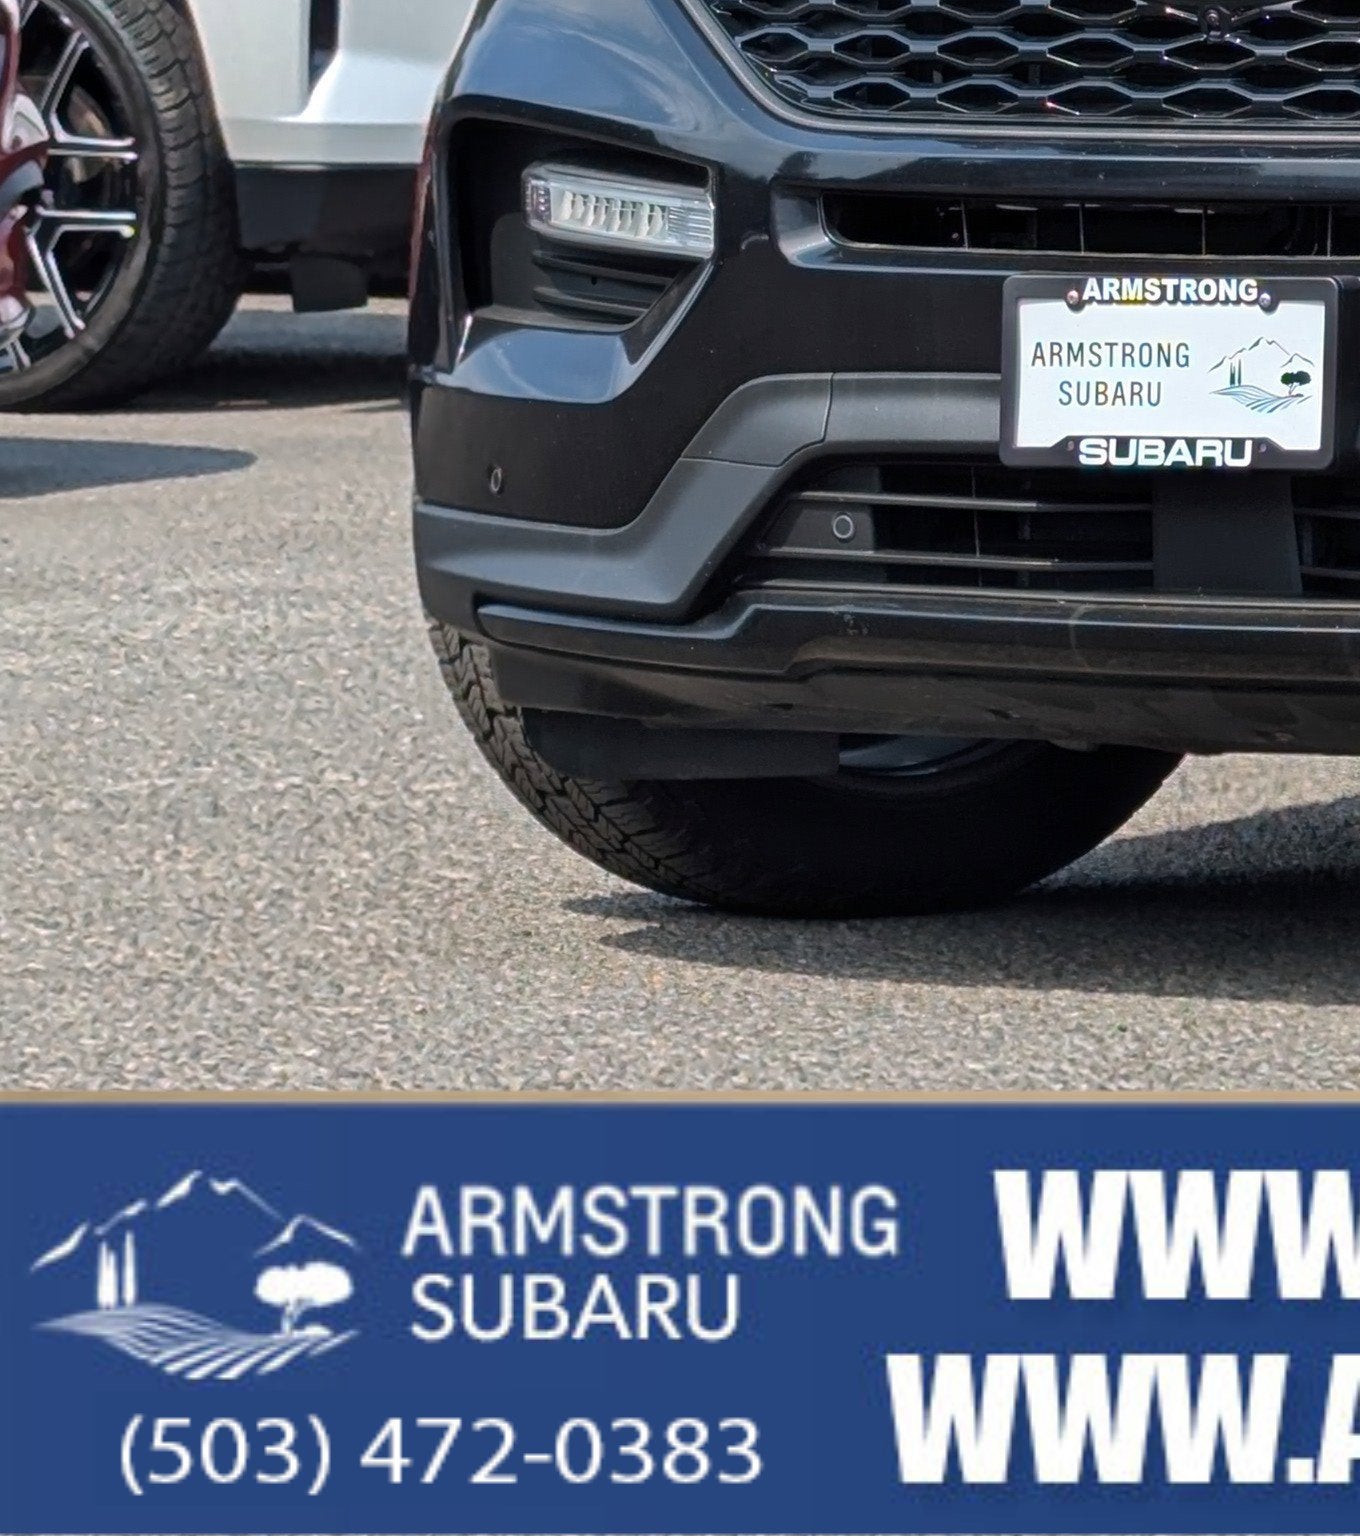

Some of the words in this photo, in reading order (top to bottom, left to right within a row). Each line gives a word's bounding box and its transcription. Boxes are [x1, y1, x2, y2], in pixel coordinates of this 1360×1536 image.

[1082, 277, 1259, 302] ARMSTRONG
[1031, 342, 1191, 368] ARMSTRONG
[1058, 381, 1162, 407] SUBARU
[1078, 438, 1253, 467] SUBARU
